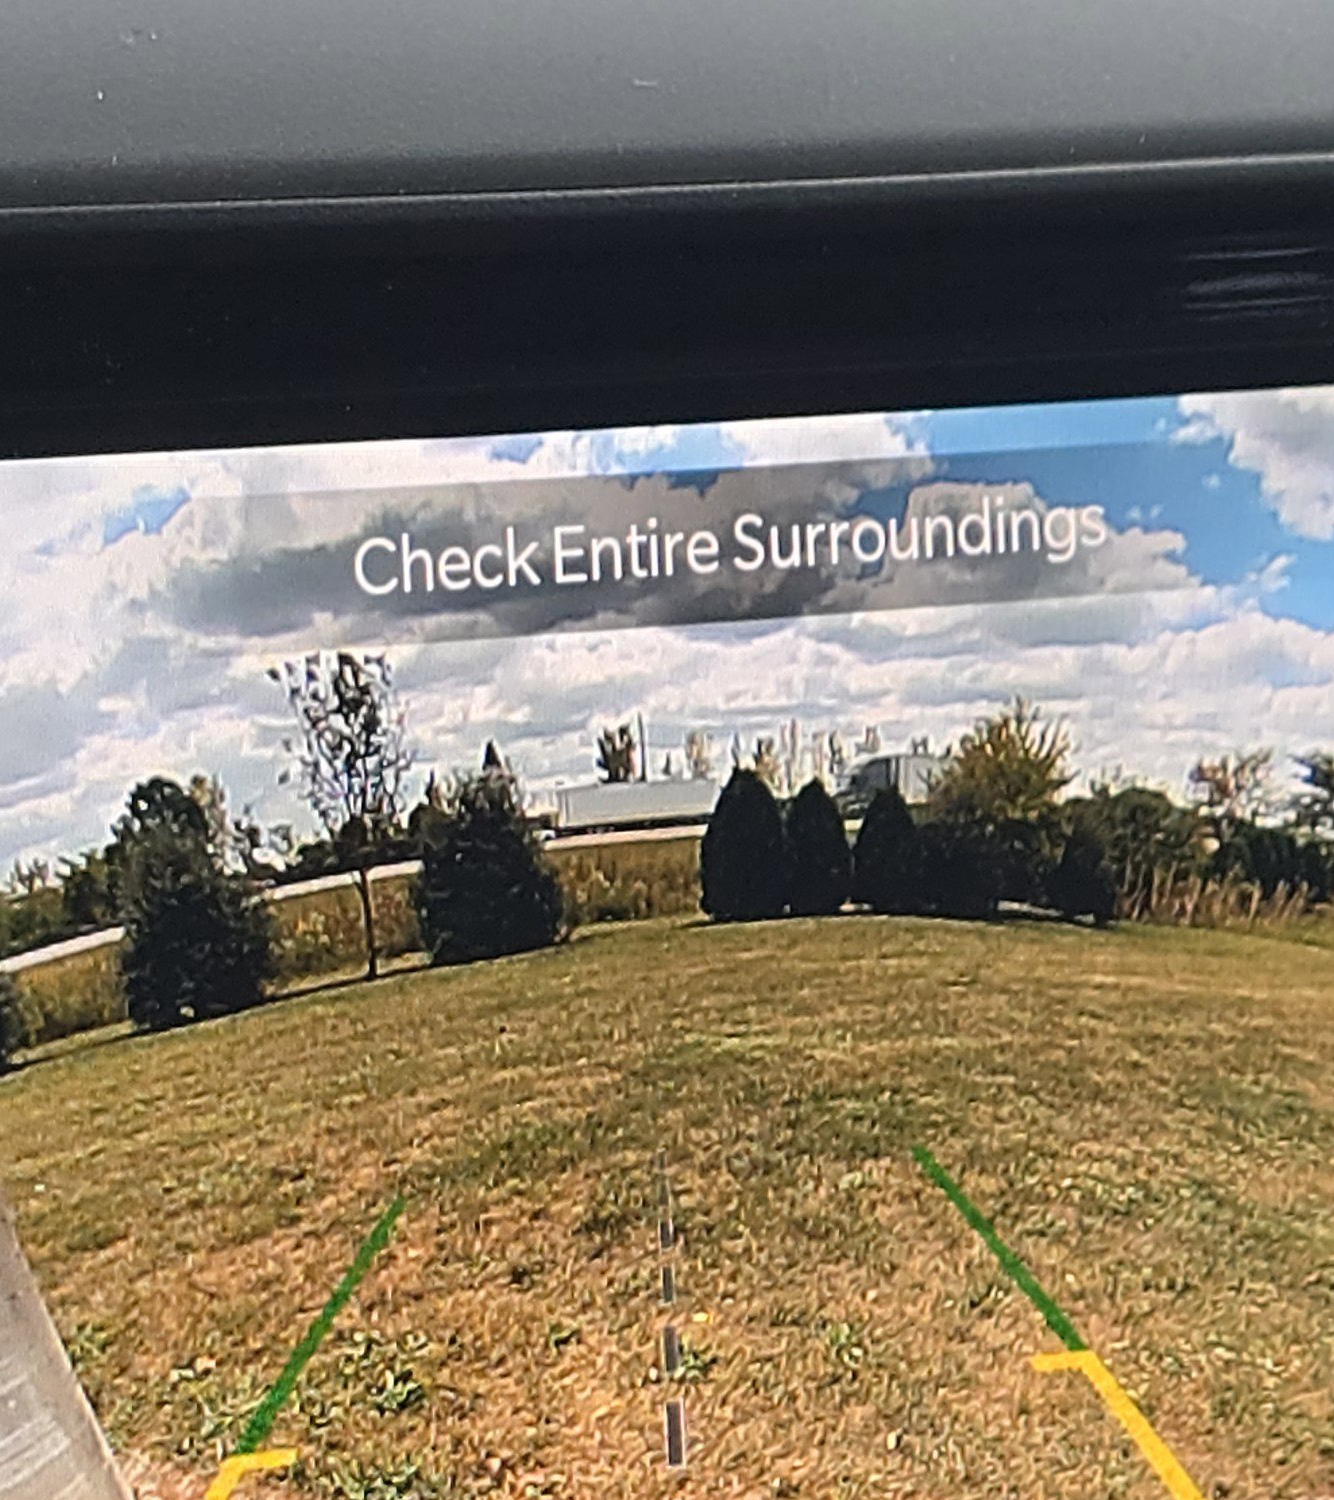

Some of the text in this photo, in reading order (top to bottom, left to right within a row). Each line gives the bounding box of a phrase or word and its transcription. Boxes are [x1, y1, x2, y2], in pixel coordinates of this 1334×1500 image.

[353, 494, 1107, 596] Check Entire Surroundings
